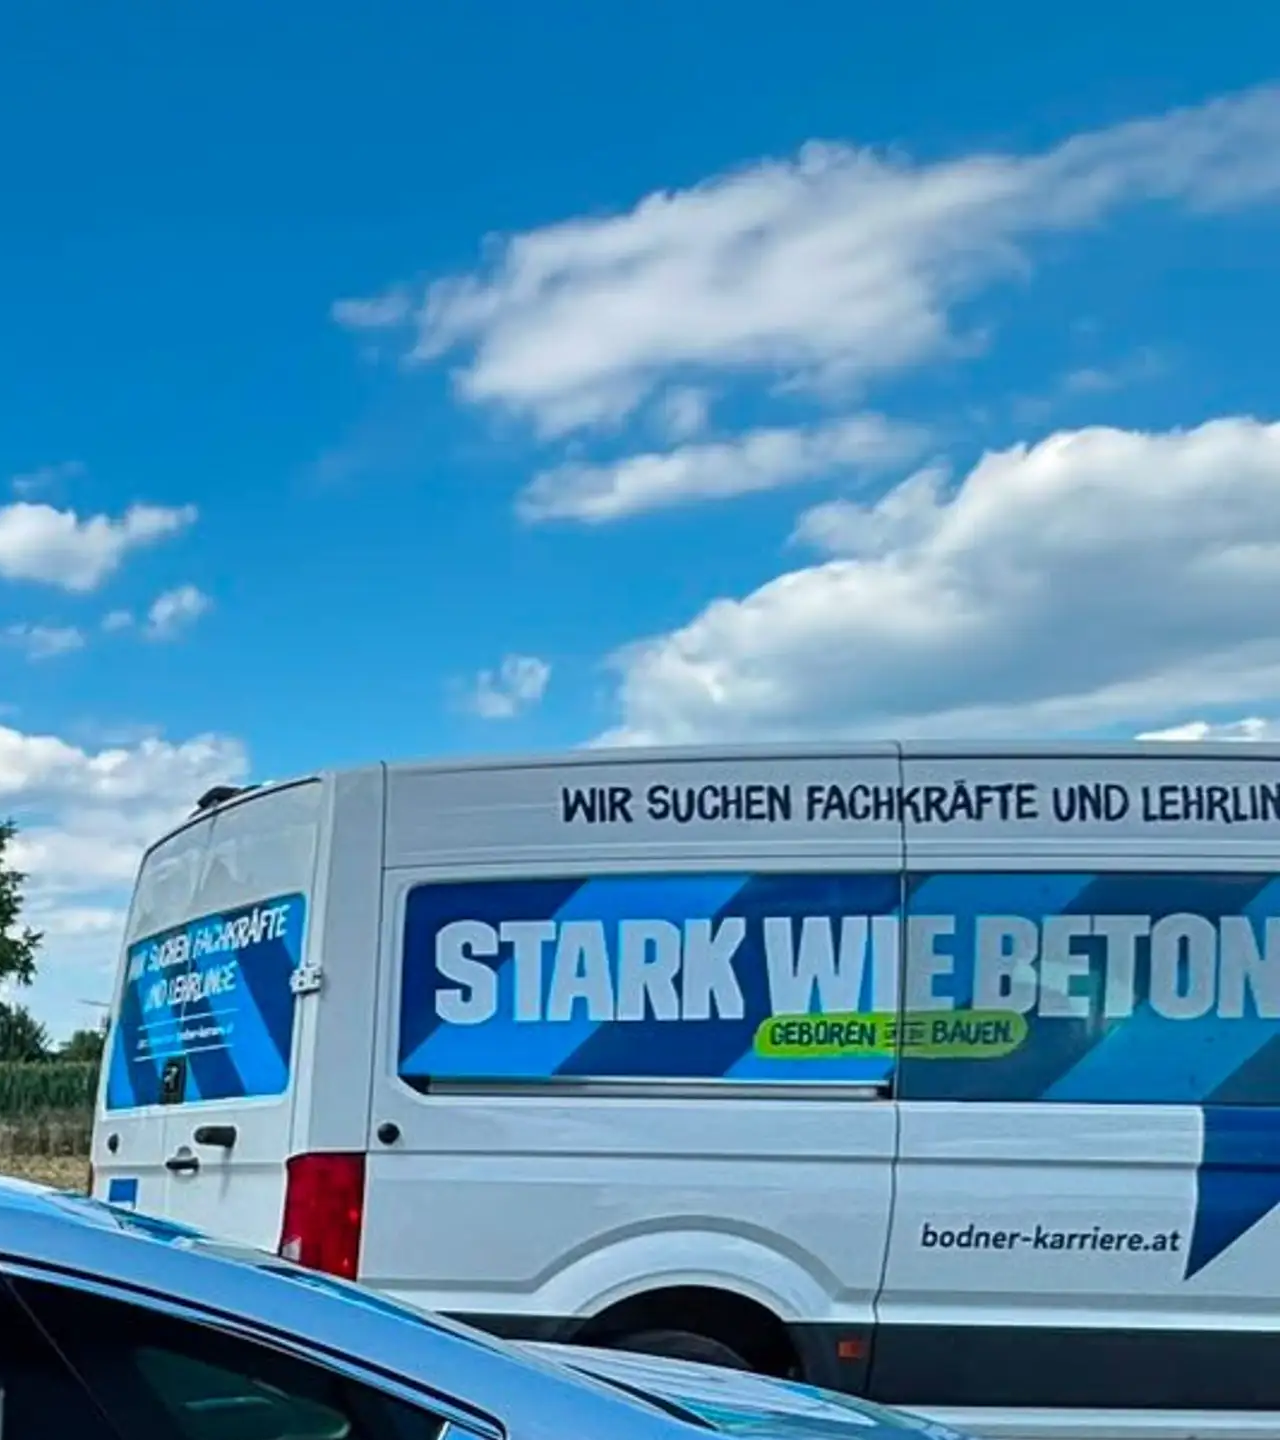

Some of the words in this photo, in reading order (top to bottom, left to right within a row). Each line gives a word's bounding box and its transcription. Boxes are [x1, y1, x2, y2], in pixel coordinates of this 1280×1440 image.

[562, 786, 634, 823] WIR
[646, 784, 791, 823] SUCHEN
[805, 780, 1039, 823] FACHKRÄFTE
[1052, 783, 1131, 822] UND
[1142, 783, 1280, 824] LEHRLIN
[435, 918, 747, 1025] STARK
[763, 913, 956, 1016] WIE
[973, 912, 1280, 1020] BETON
[769, 1021, 877, 1047] GEBOREN
[920, 1222, 1183, 1253] bodner-karriere.at
